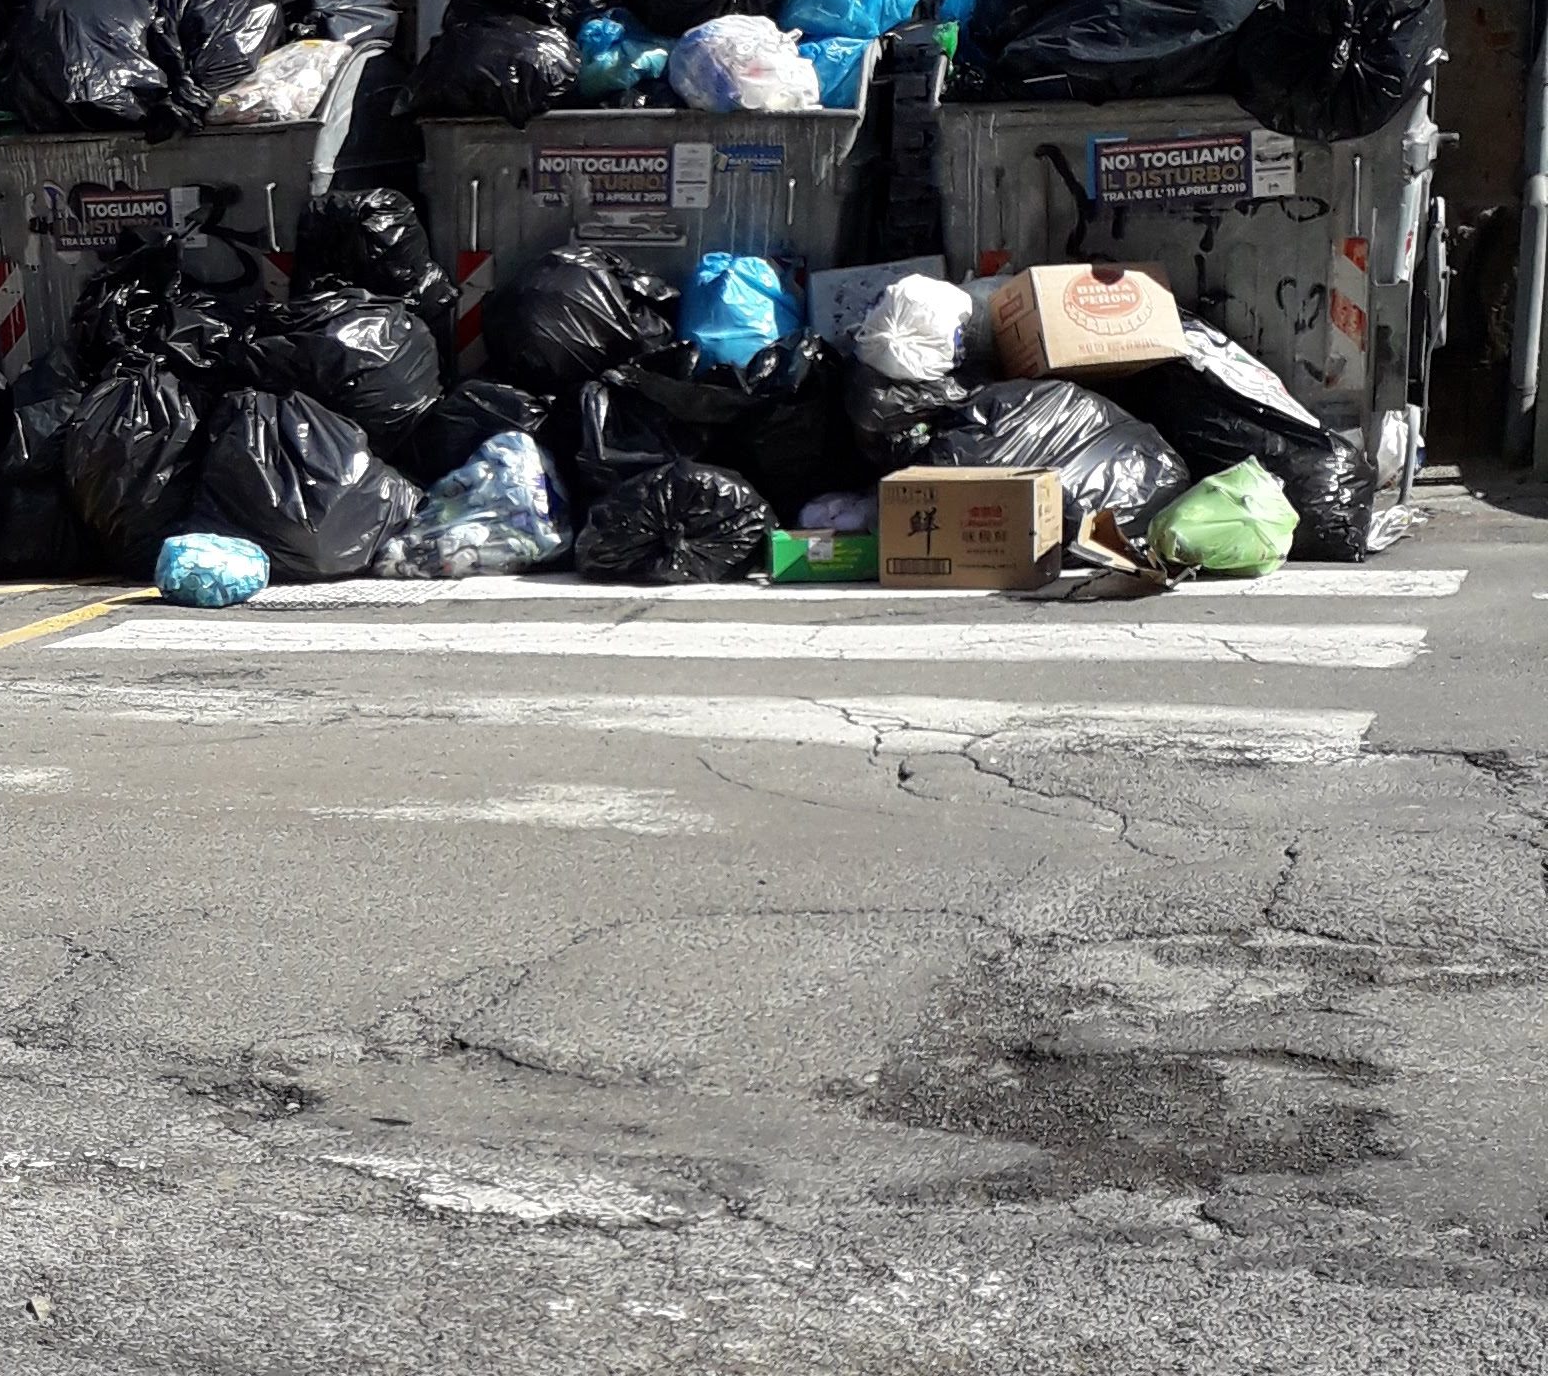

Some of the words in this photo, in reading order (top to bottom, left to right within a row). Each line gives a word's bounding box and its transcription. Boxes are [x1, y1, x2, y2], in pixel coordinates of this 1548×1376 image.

[573, 157, 668, 173] TOGLIAMO
[1139, 146, 1245, 169] TOGLIAMO
[1102, 173, 1119, 191] IL
[1125, 164, 1245, 189] DISTURBO!
[1102, 192, 1125, 203] TRA
[1178, 184, 1218, 197] APRILE
[1220, 182, 1246, 194] 2019
[87, 201, 167, 218] TOGLIAMO
[1076, 283, 1132, 295] BIRRA
[1079, 293, 1137, 306] PERONI
